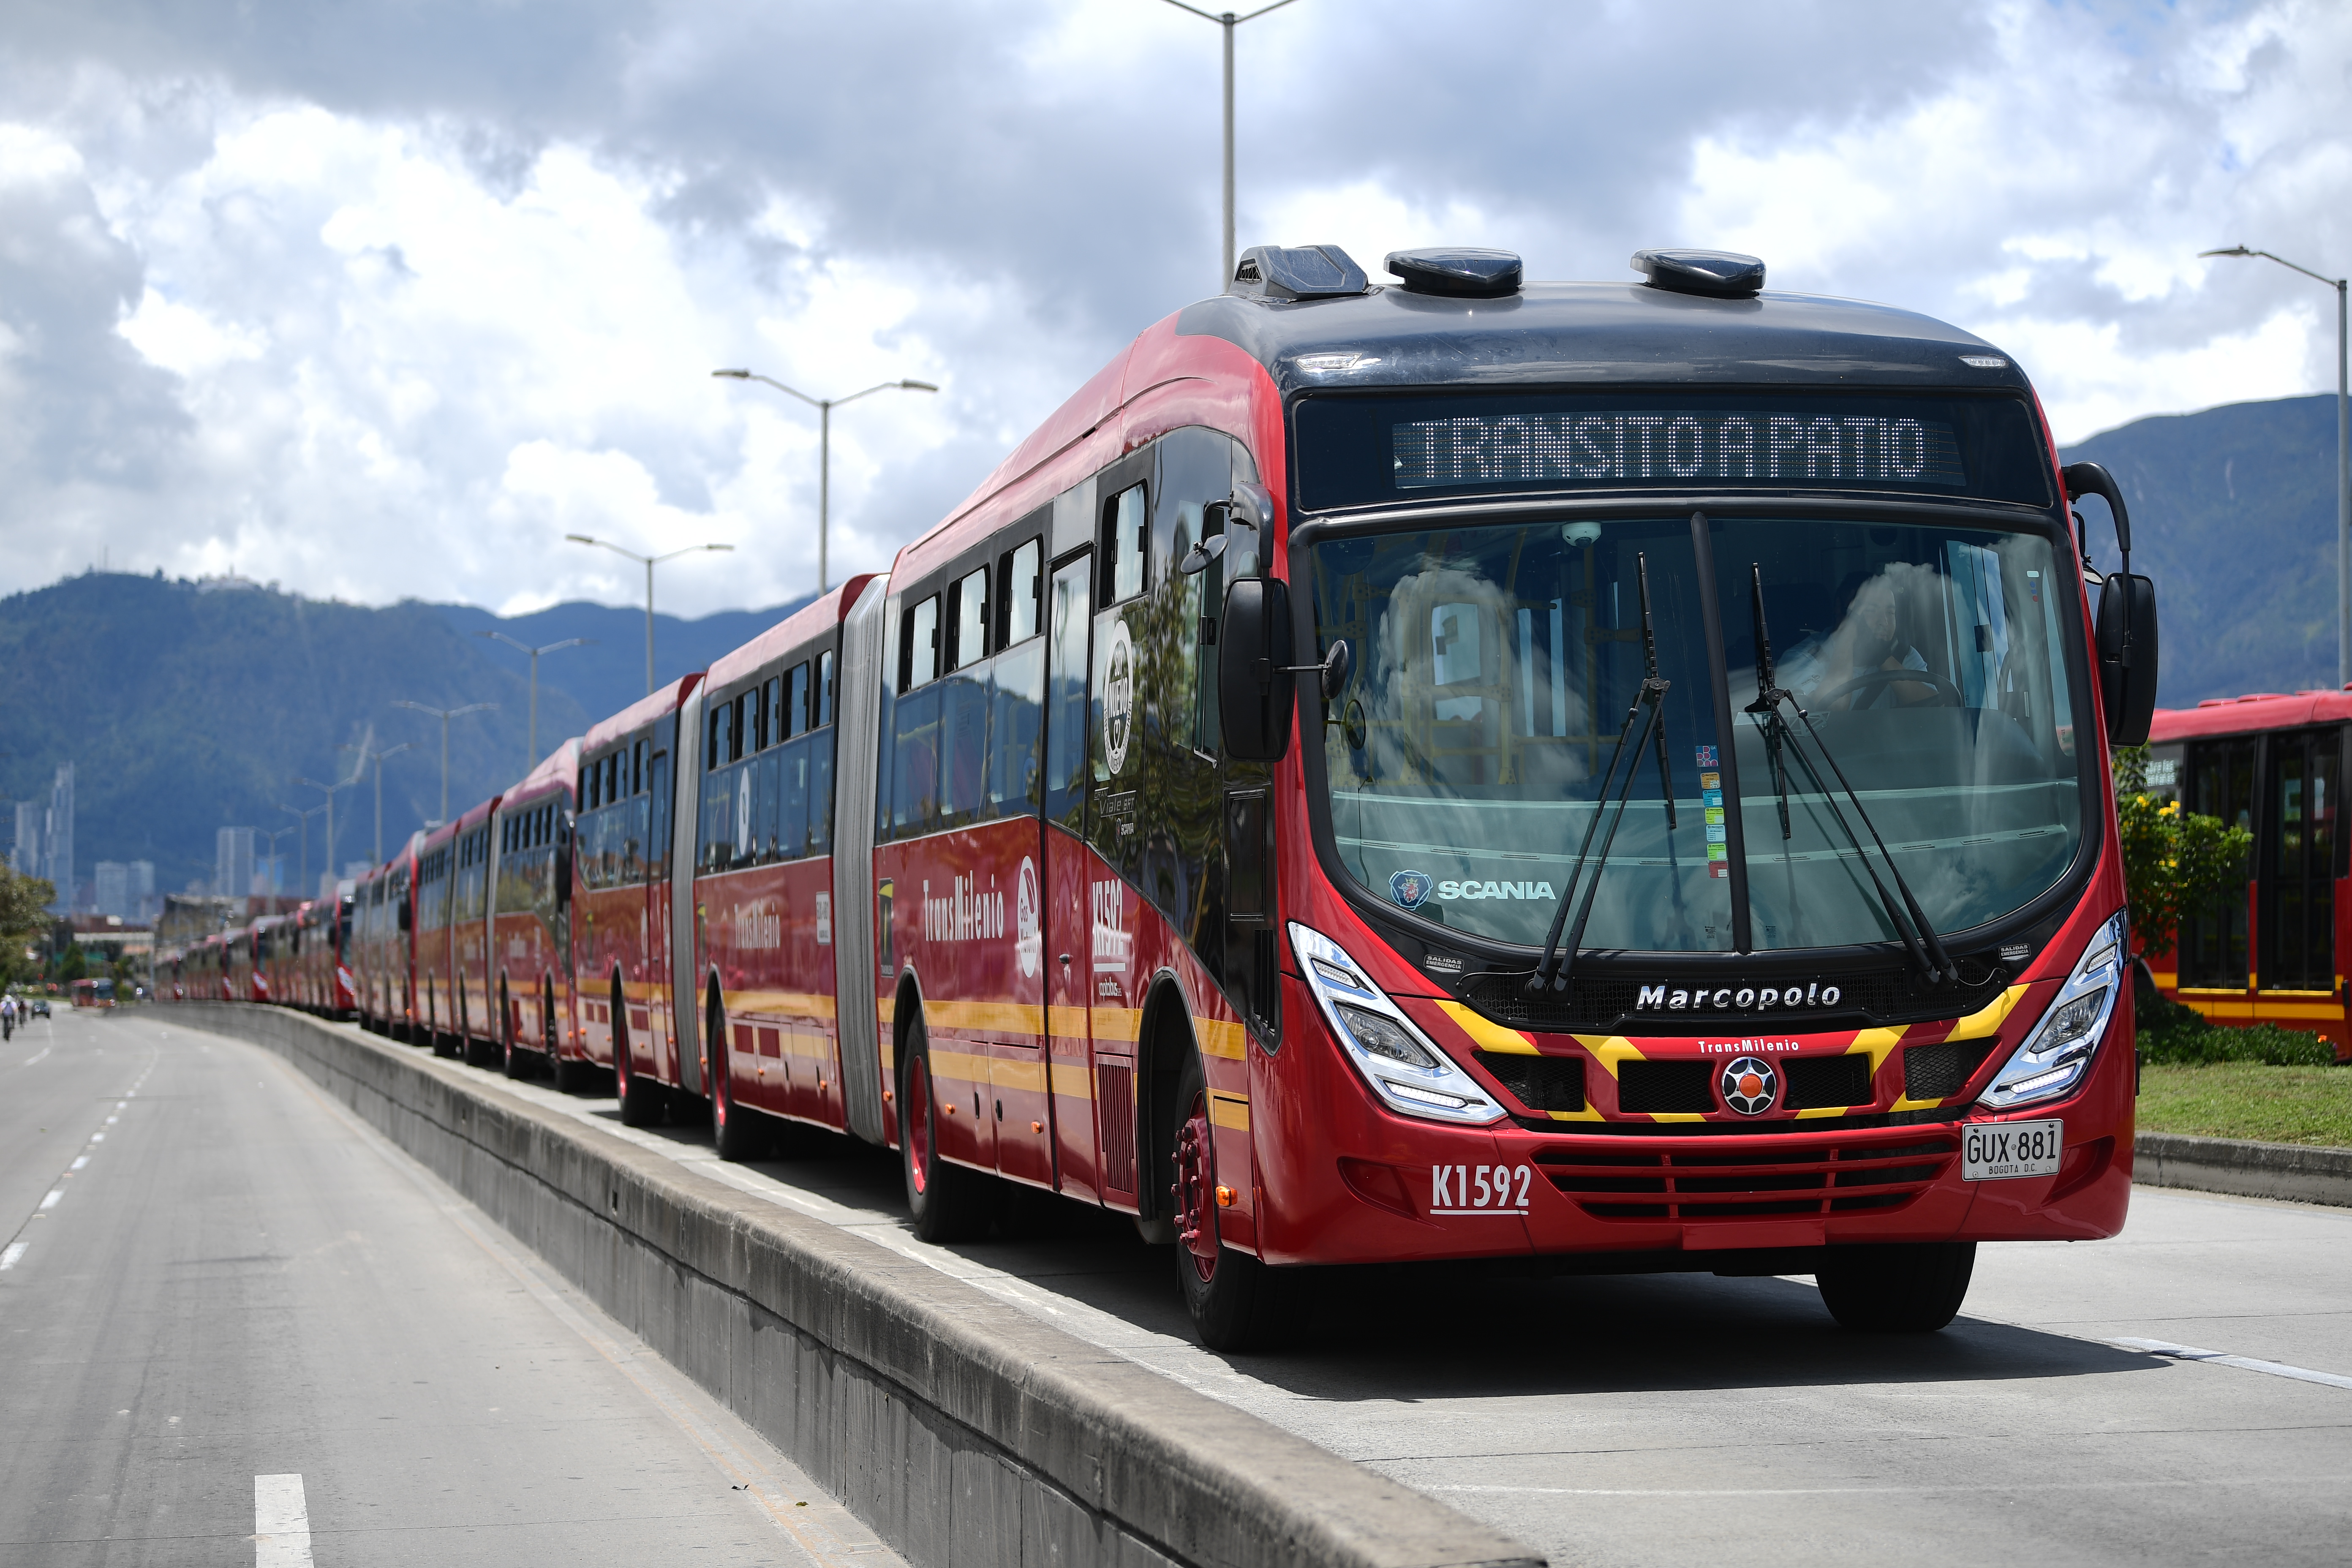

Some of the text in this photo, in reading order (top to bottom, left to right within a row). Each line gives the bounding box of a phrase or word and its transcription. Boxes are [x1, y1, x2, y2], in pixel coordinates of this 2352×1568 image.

[1412, 416, 1923, 478] TRANSITO A PATIO
[1114, 648, 1124, 677] SOY
[1108, 677, 1128, 719] NUEVO
[1094, 790, 1108, 798] GRAN
[1100, 797, 1135, 814] Viale BRT
[1121, 822, 1134, 836] SCANIA
[1437, 880, 1556, 900] SCANIA
[923, 870, 1004, 942] TransMilenio
[1020, 897, 1028, 923] Gas
[1092, 878, 1124, 957] K1592
[734, 898, 781, 949] TransMilenio
[1426, 960, 1461, 969] EMERGENCIA
[1427, 956, 1462, 965] SALIDAS
[1636, 983, 1841, 1011] Marcopolo
[1698, 1038, 1799, 1054] TransMilenio
[1968, 1130, 2056, 1164] GUX 881
[1989, 1164, 2037, 1175] BOGOTA D.C.
[1432, 1165, 1531, 1207] K1592
